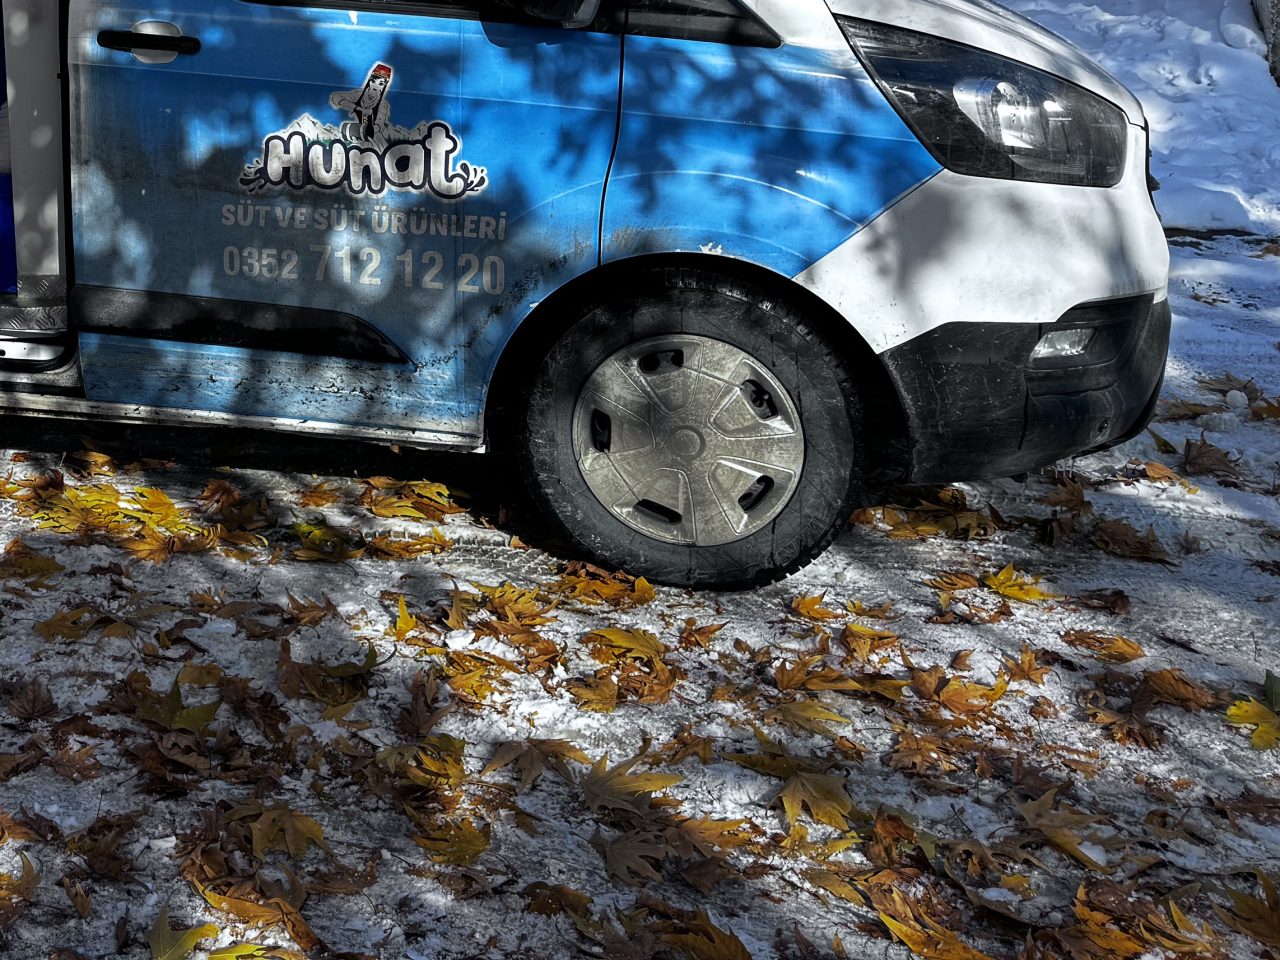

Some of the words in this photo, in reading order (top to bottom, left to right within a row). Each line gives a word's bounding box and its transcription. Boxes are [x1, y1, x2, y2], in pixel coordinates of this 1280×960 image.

[264, 121, 468, 200] Hunat
[221, 199, 272, 227] SÜT
[273, 206, 307, 229] VE
[313, 203, 366, 232] SÜT
[370, 205, 507, 240] ÜRÜNLERİ
[222, 245, 299, 280] 0352
[310, 244, 383, 286] 712
[396, 250, 445, 290] 12
[456, 253, 506, 295] 20
